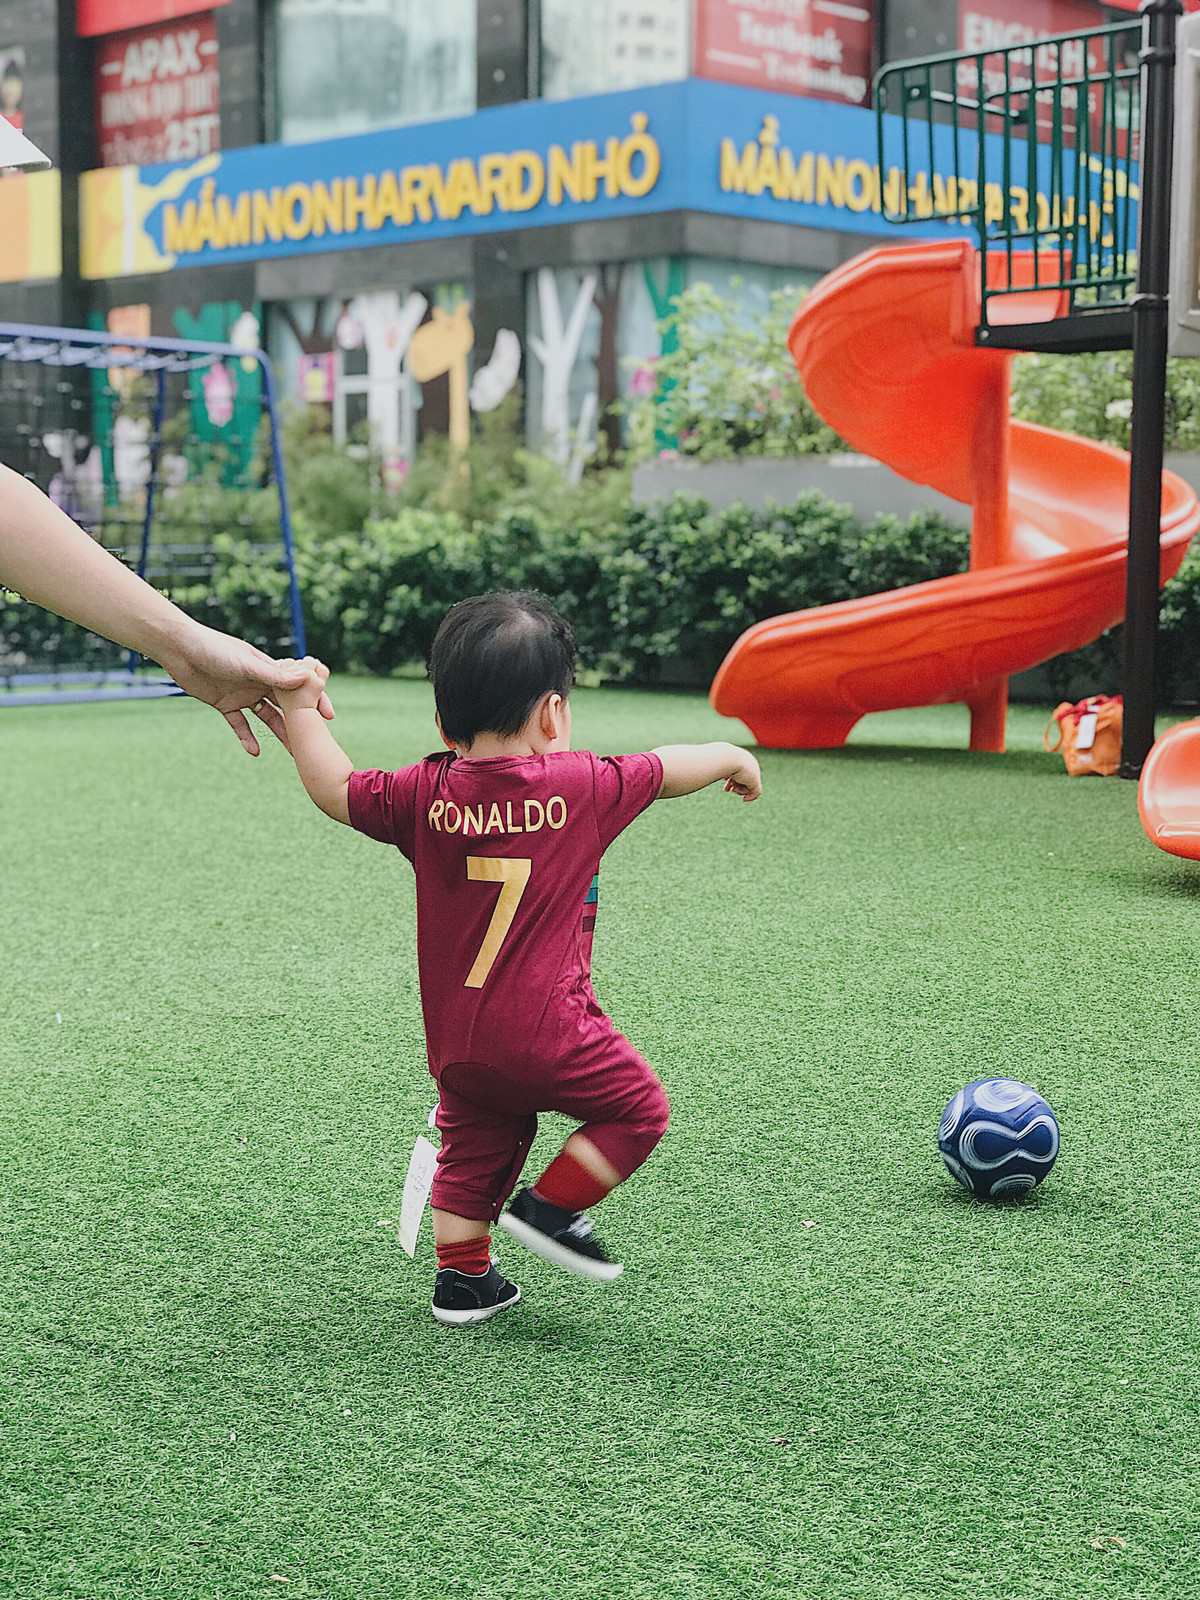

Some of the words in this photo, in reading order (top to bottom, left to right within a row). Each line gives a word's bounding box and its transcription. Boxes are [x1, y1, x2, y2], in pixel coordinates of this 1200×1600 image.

[121, 29, 201, 87] APAX
[253, 181, 343, 242] NON
[344, 150, 545, 230] HARVARD
[815, 156, 900, 214] NON
[428, 795, 568, 836] RONALDO
[464, 856, 532, 989] 7
